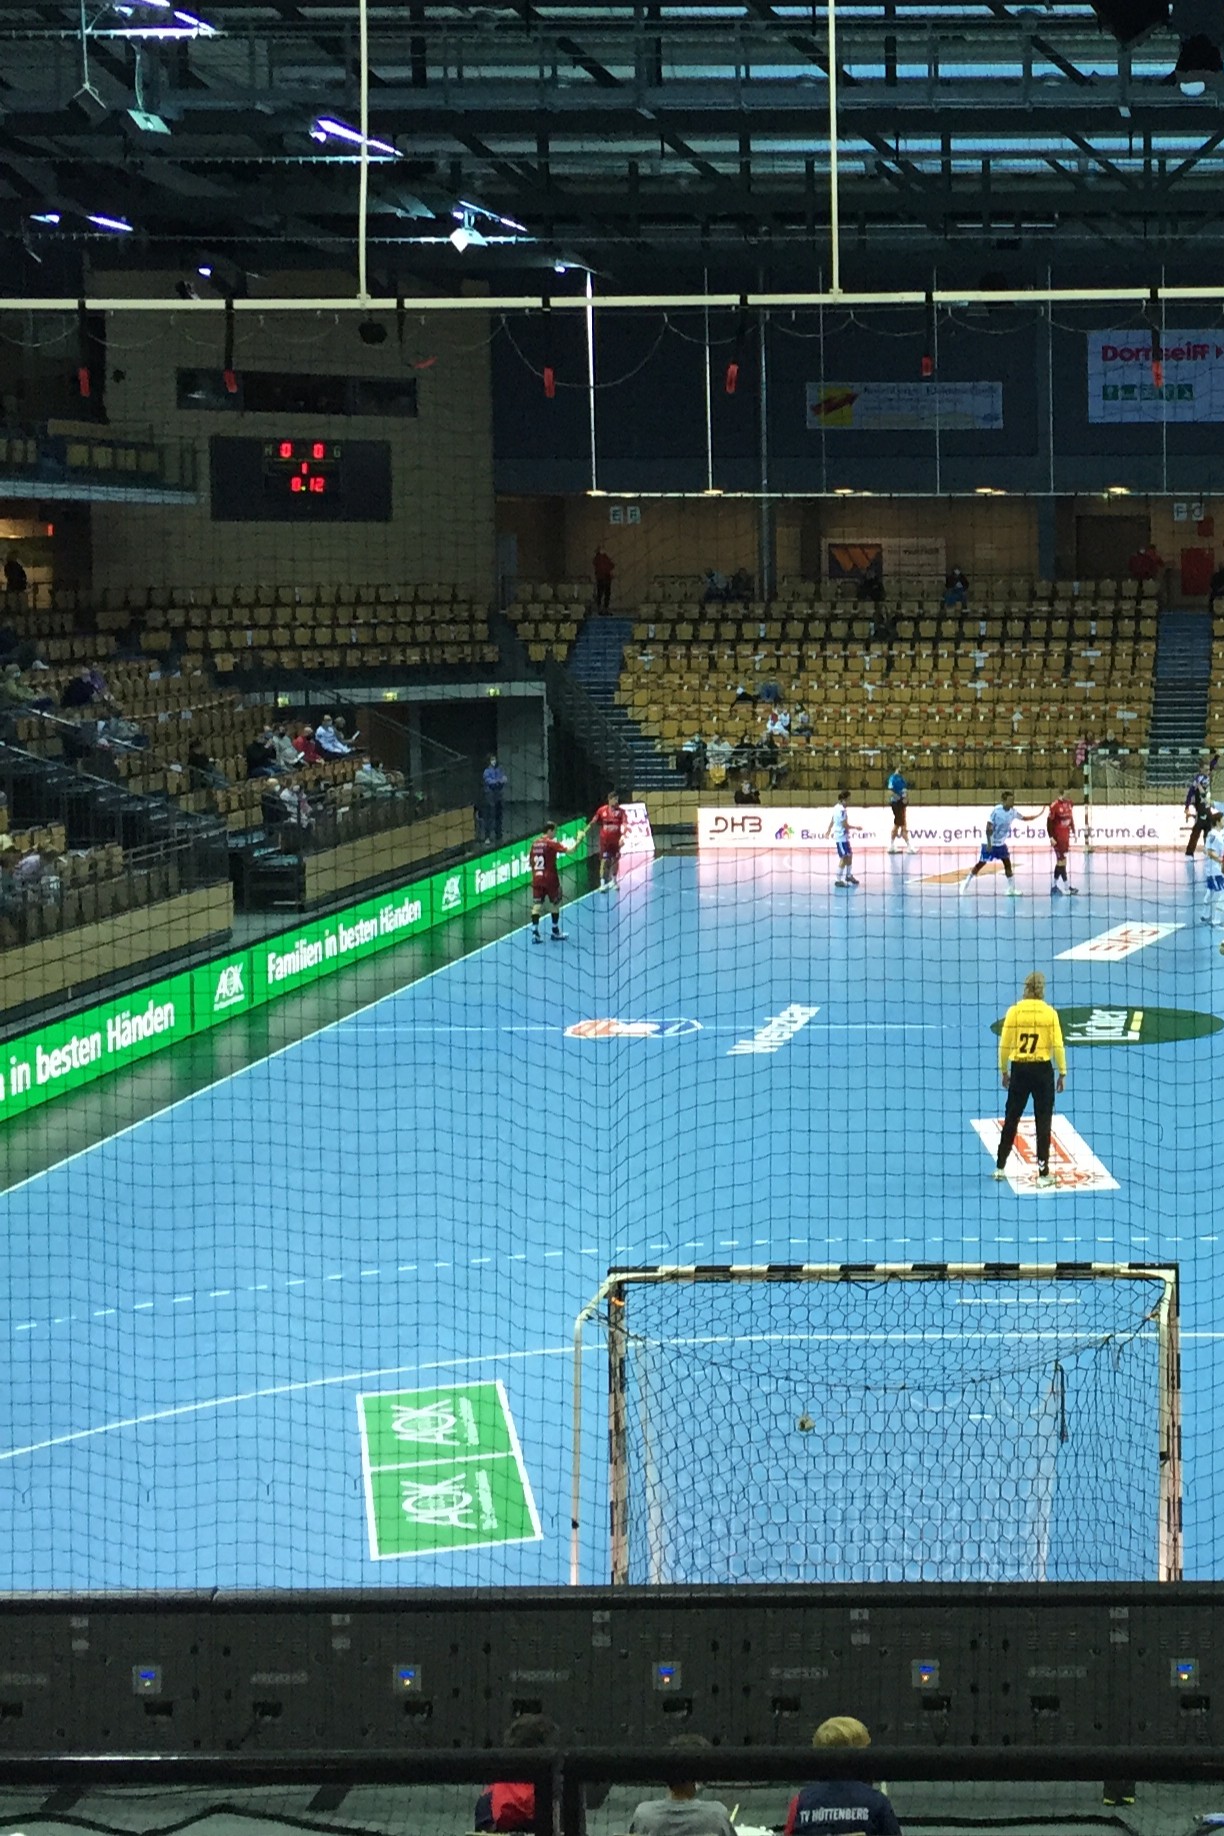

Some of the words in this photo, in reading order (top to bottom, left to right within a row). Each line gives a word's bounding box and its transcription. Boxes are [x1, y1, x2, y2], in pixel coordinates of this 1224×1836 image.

[709, 816, 762, 834] DHB
[267, 935, 323, 985] Familien
[324, 929, 338, 959] in
[338, 914, 378, 953] besten
[379, 896, 422, 934] Händen
[214, 962, 244, 1002] AOK
[10, 1055, 31, 1096] in
[36, 1032, 102, 1085] besten
[106, 999, 175, 1053] Händen
[1019, 1033, 1039, 1054] 27
[391, 1399, 461, 1446] AOK
[401, 1472, 477, 1529] AOK
[800, 1811, 810, 1823] TV
[812, 1806, 869, 1822] HÜTTENBERG
